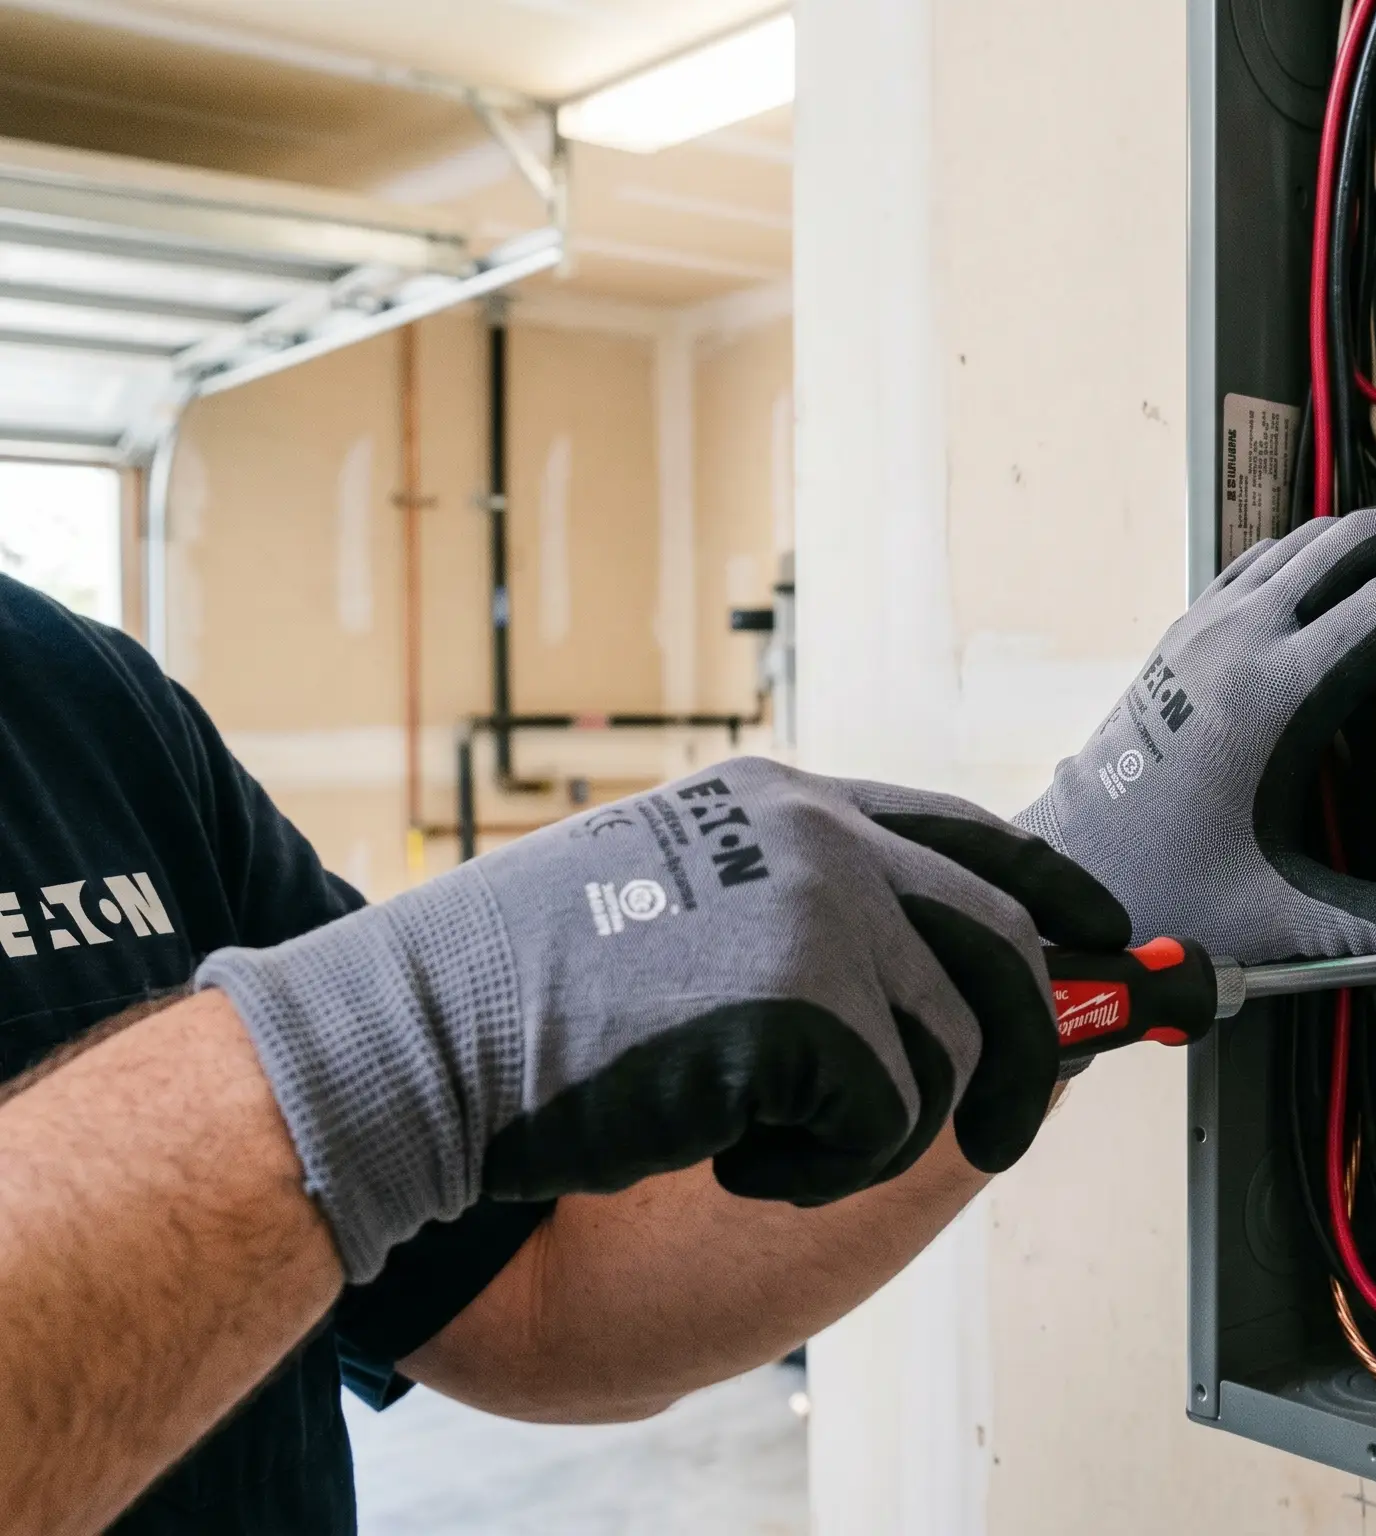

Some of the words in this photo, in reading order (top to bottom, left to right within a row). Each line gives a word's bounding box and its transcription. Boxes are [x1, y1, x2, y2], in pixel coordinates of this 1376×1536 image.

[1143, 654, 1194, 733] EATON
[677, 778, 770, 887] EATON
[0, 872, 175, 958] EATON
